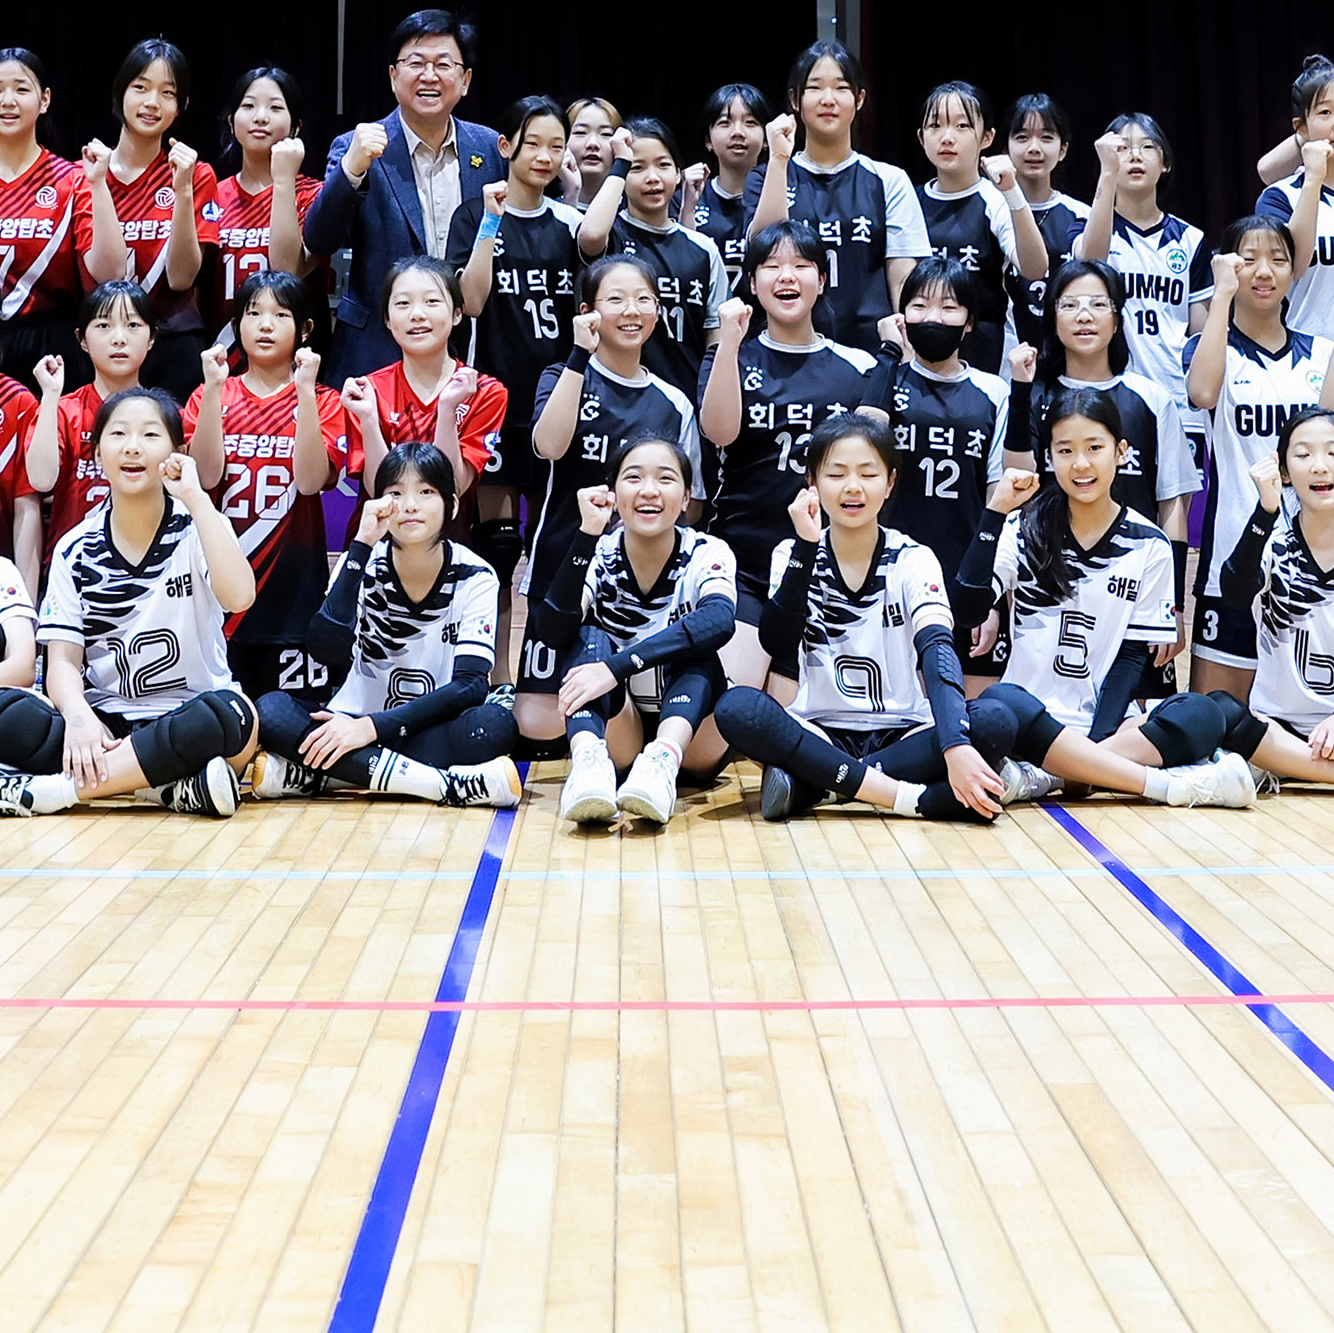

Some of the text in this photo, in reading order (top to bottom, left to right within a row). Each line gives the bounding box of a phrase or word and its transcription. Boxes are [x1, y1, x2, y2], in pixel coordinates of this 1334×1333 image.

[523, 298, 560, 341] 15
[1134, 309, 1159, 336] 19
[893, 423, 987, 460] 회덕초
[222, 465, 298, 520] 26
[918, 456, 961, 500] 12
[1107, 575, 1142, 604] 해밀
[1052, 610, 1096, 680] 5
[1202, 609, 1219, 642] 3
[107, 628, 187, 699] 12
[524, 638, 556, 680] 10
[835, 655, 886, 713] 9
